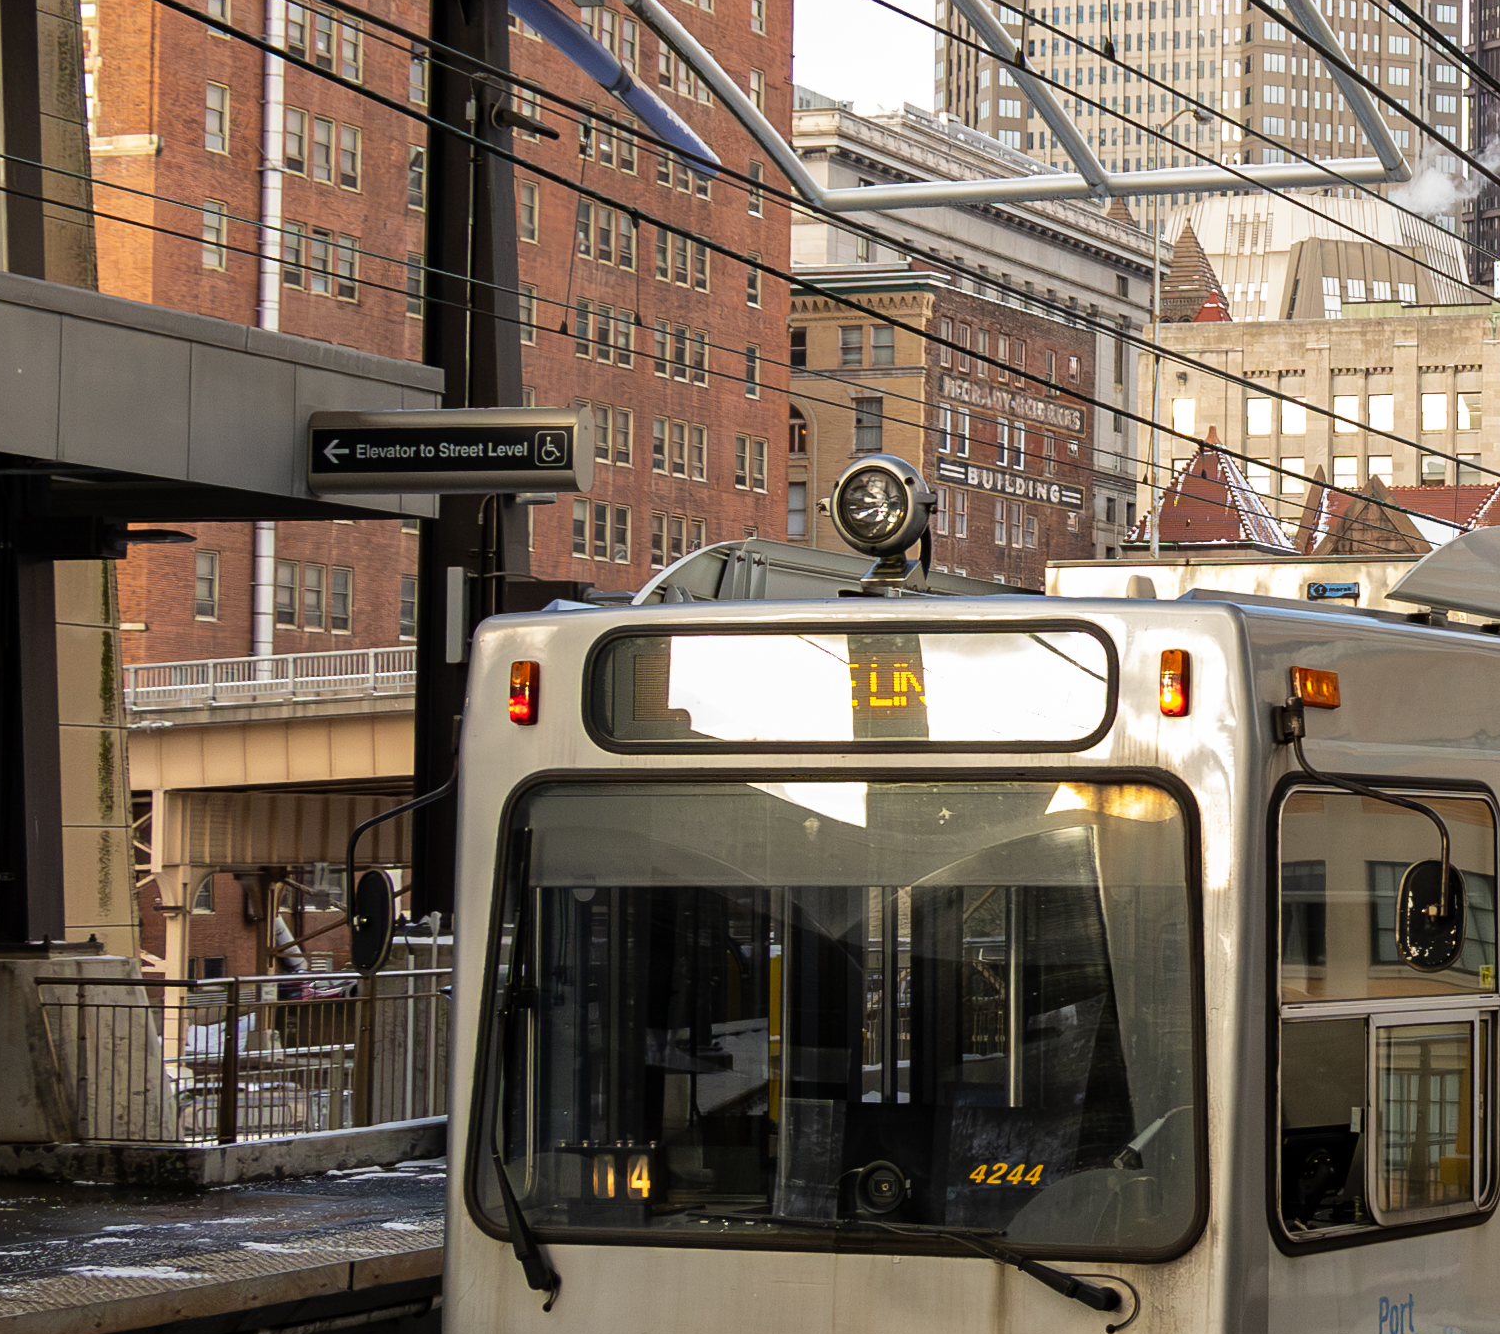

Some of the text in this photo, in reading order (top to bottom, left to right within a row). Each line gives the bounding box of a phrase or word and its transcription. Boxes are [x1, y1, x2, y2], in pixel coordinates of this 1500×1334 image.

[356, 441, 528, 459] Elevator to Street Level
[967, 466, 1060, 503] BUILDING
[968, 1162, 1043, 1186] 4244
